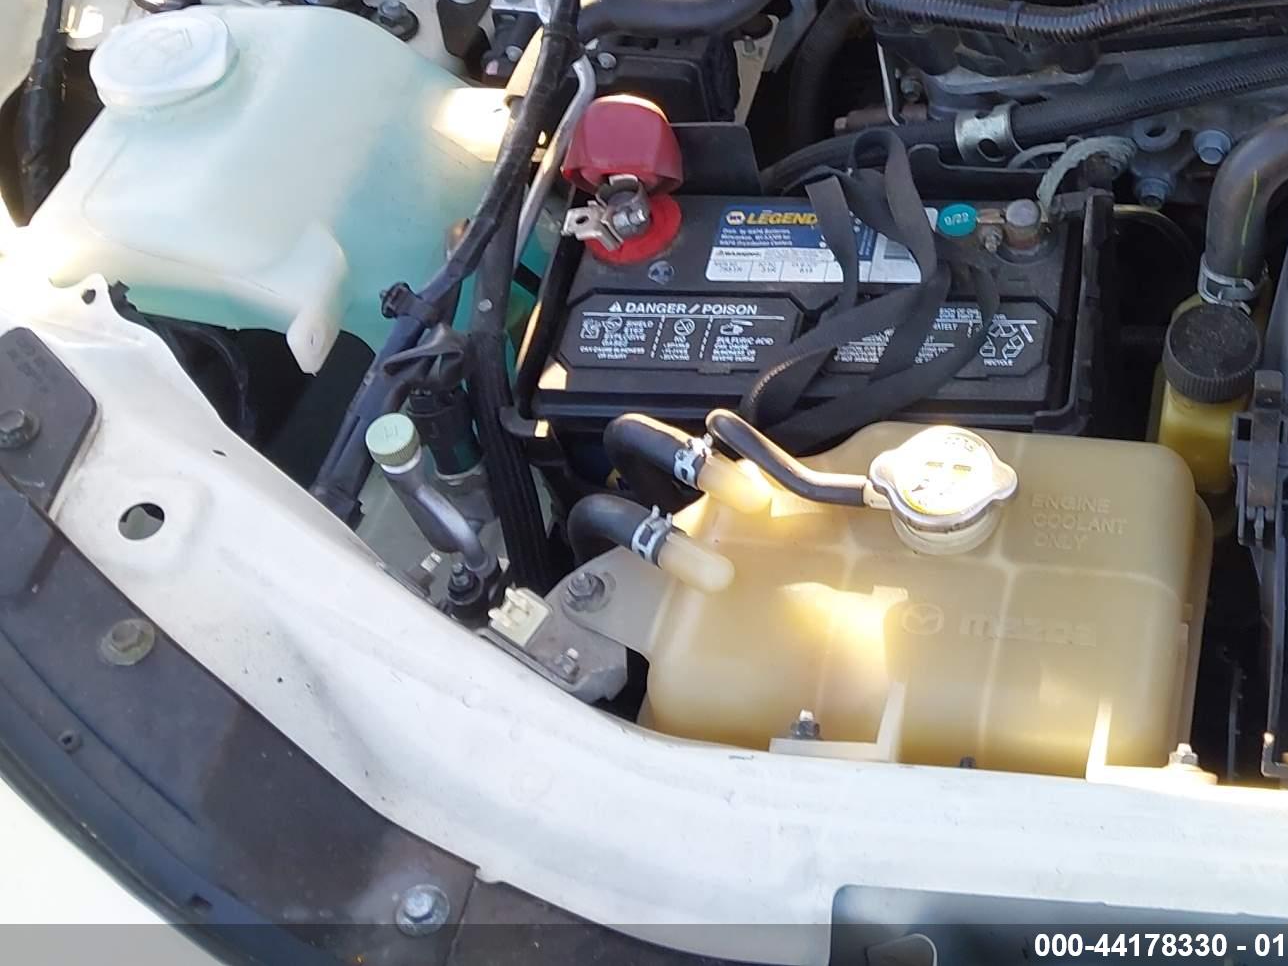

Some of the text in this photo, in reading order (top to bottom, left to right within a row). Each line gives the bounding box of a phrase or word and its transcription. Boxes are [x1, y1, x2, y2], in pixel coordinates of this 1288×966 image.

[746, 211, 818, 225] LEGEND
[625, 302, 687, 314] DANGER
[702, 304, 757, 315] POISON
[1032, 493, 1112, 513] ENGINE
[1031, 512, 1129, 535] COOLANT
[1033, 531, 1088, 551] ONLY
